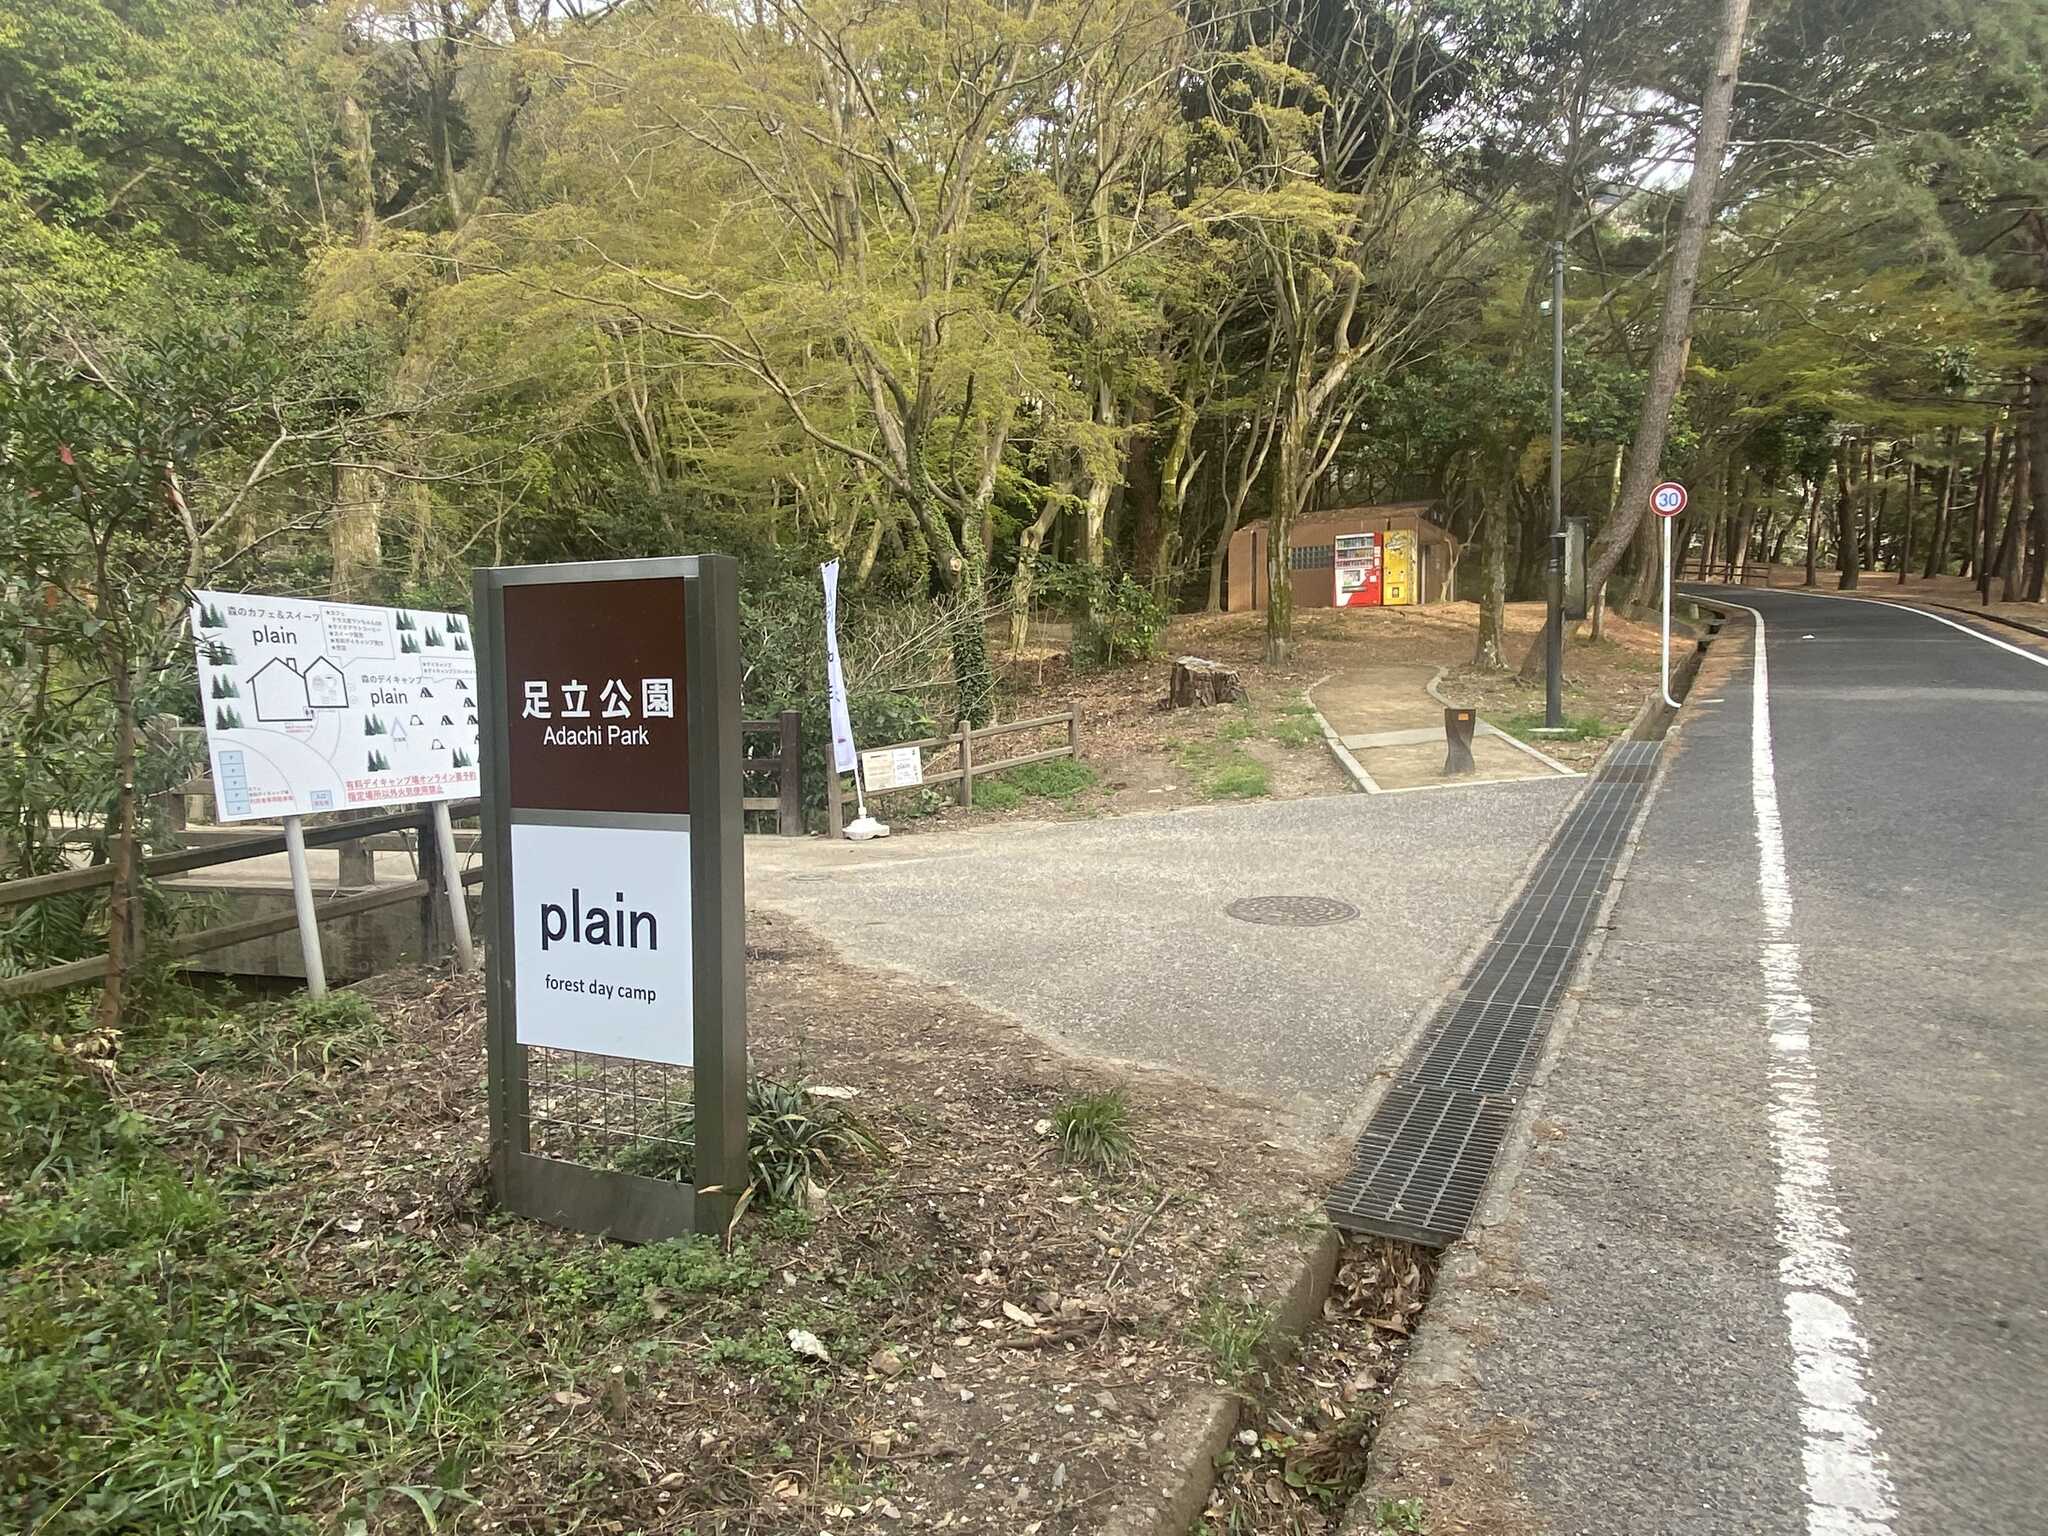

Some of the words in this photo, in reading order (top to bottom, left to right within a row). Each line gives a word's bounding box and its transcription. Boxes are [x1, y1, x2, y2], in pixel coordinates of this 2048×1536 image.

[1659, 492, 1678, 507] 30
[252, 624, 298, 646] plain
[370, 687, 408, 708] plain
[521, 677, 675, 720] 足立公園
[543, 724, 602, 747] Adachi
[608, 724, 649, 747] Park
[541, 887, 659, 952] plain
[545, 974, 585, 993] forest
[588, 977, 614, 1001] day
[617, 983, 657, 1004] camp
